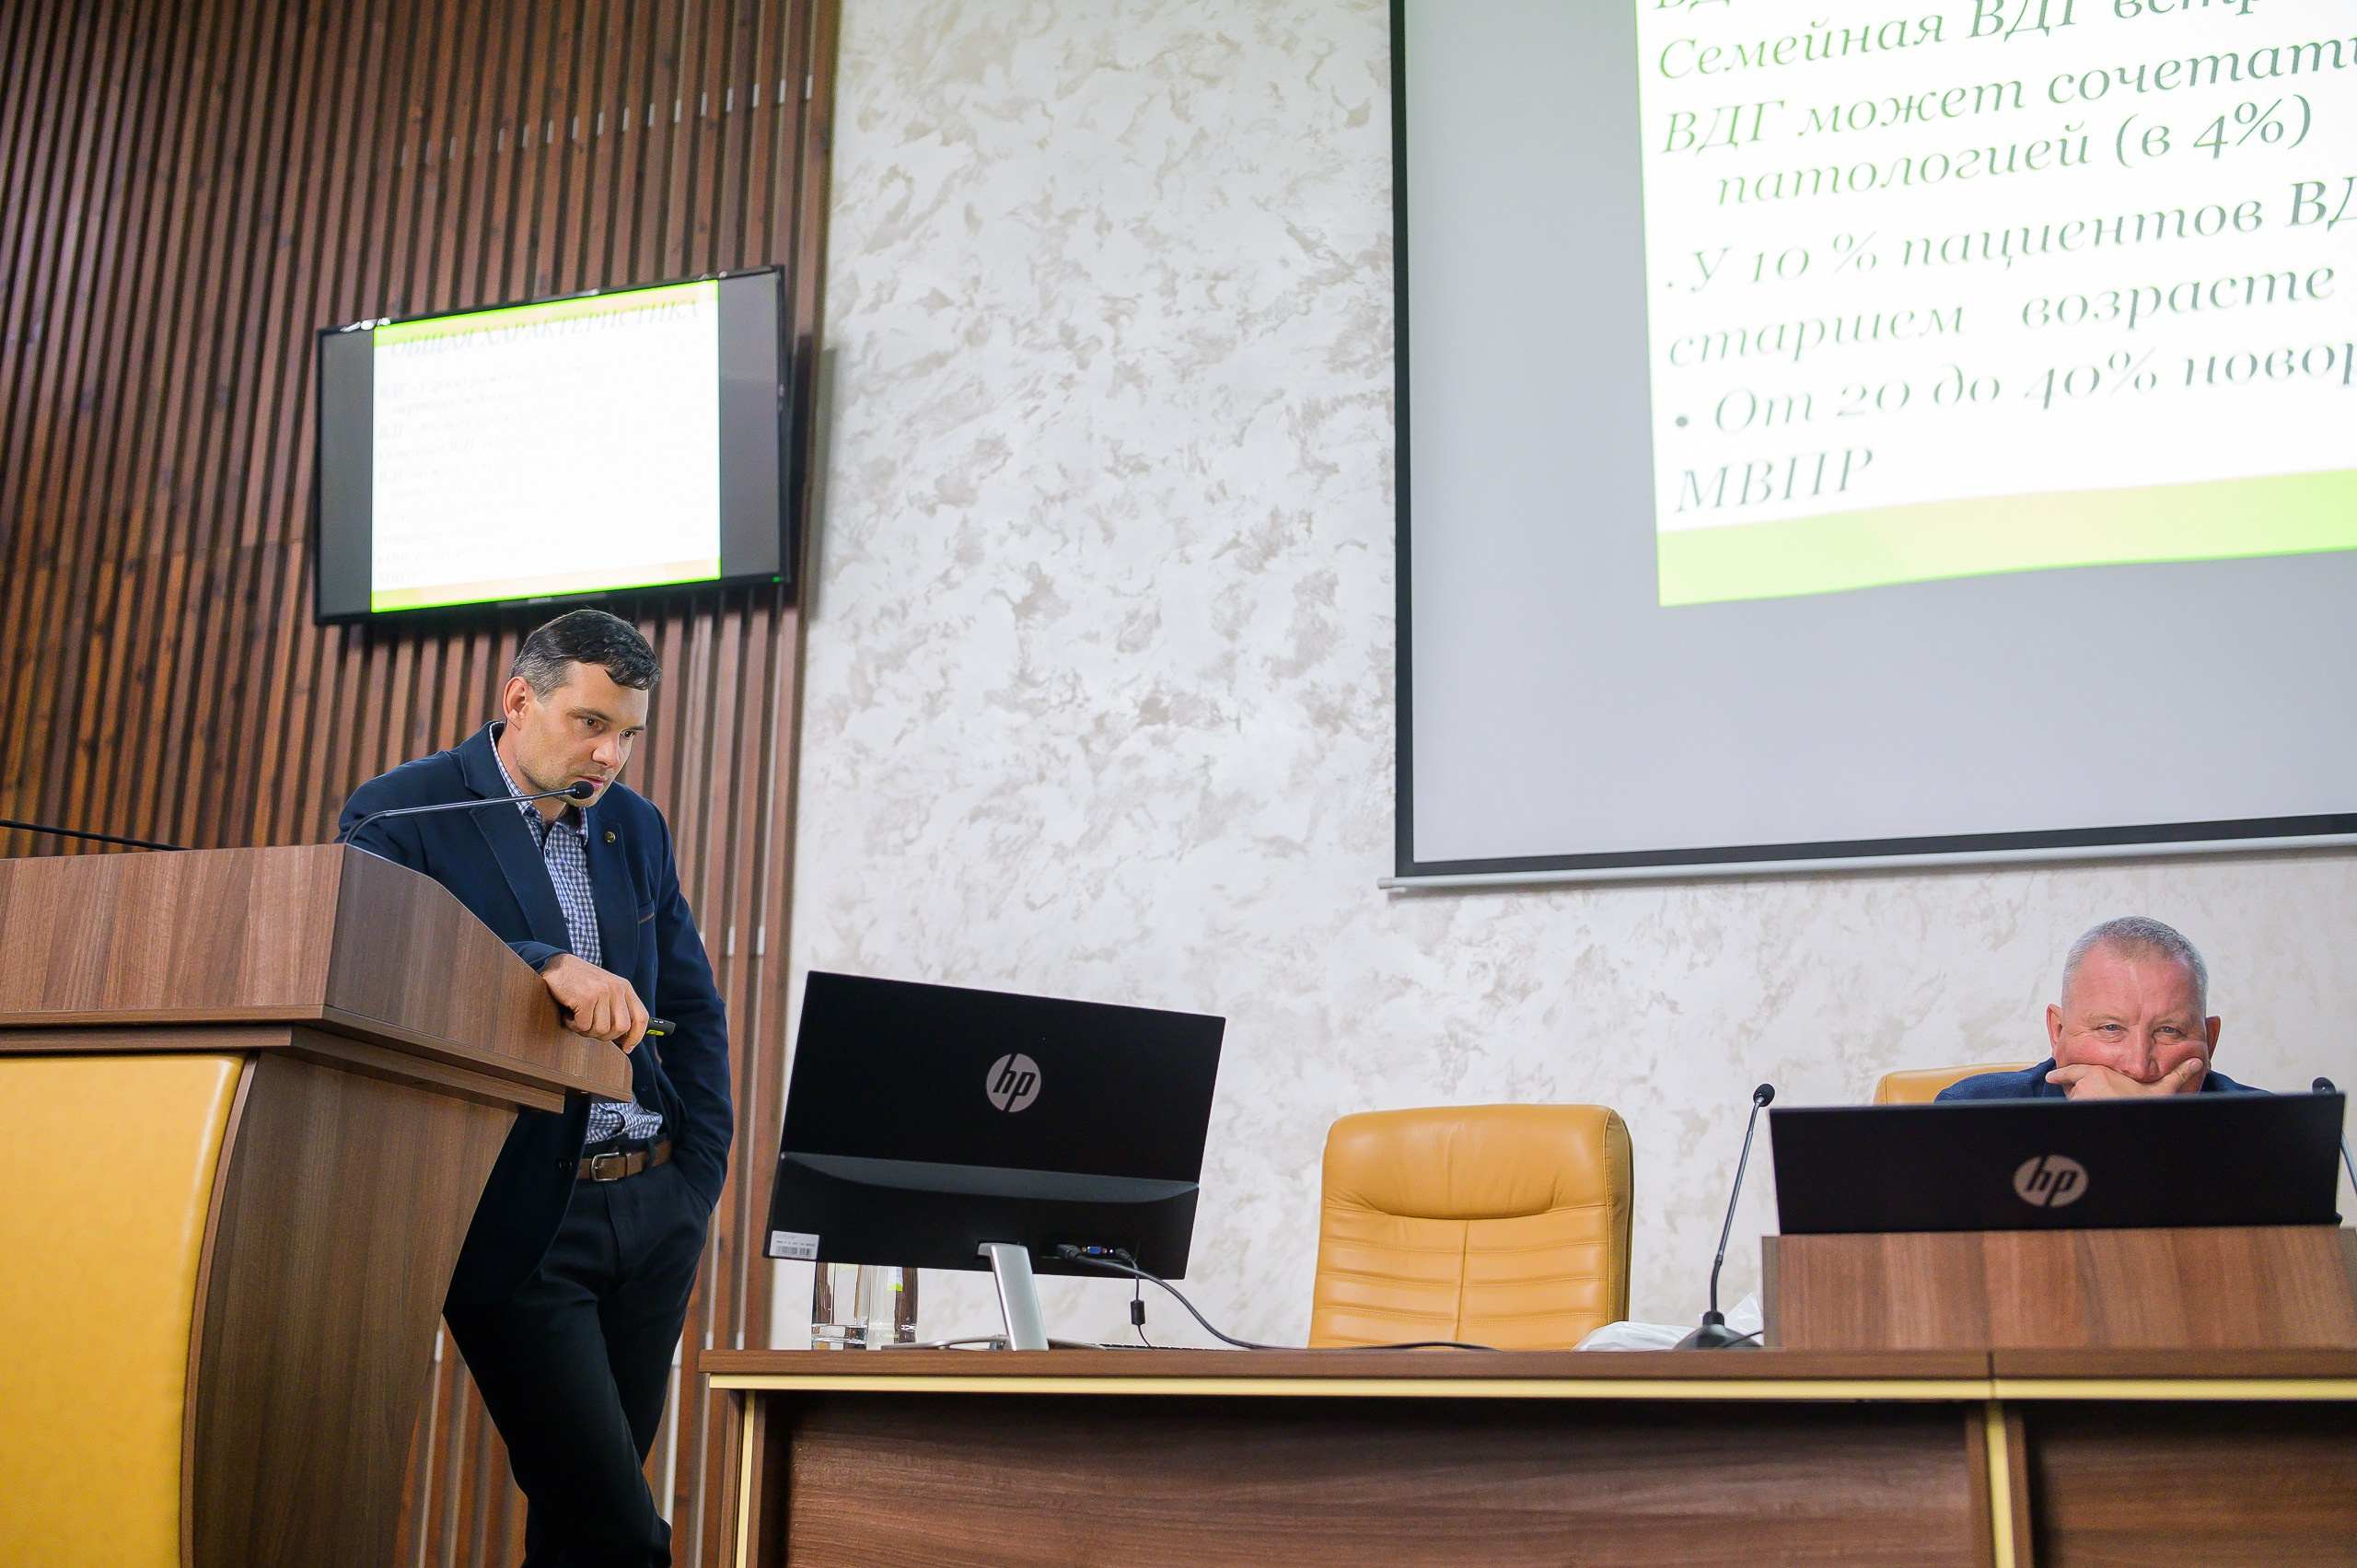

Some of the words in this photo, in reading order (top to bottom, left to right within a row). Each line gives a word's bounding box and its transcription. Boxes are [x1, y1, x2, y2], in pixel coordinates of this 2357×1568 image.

[1659, 15, 1945, 79] Семейная
[1663, 99, 1786, 156] ВДГ
[1797, 80, 2026, 137] может
[1719, 120, 2090, 206] патологией
[2116, 113, 2170, 168] (в
[2192, 93, 2311, 160] 4%)
[1750, 247, 1810, 285] 10
[1903, 199, 2263, 270] пациентов
[1669, 306, 1966, 366] старшем
[2022, 266, 2336, 331] возрасте
[1713, 387, 1813, 435] От
[1836, 381, 1911, 418] 20
[1933, 362, 2002, 407] до
[2023, 346, 2158, 412] 40%
[1675, 447, 1875, 512] МВПР
[993, 1053, 1036, 1112] hp
[2026, 1155, 2078, 1207] hp
